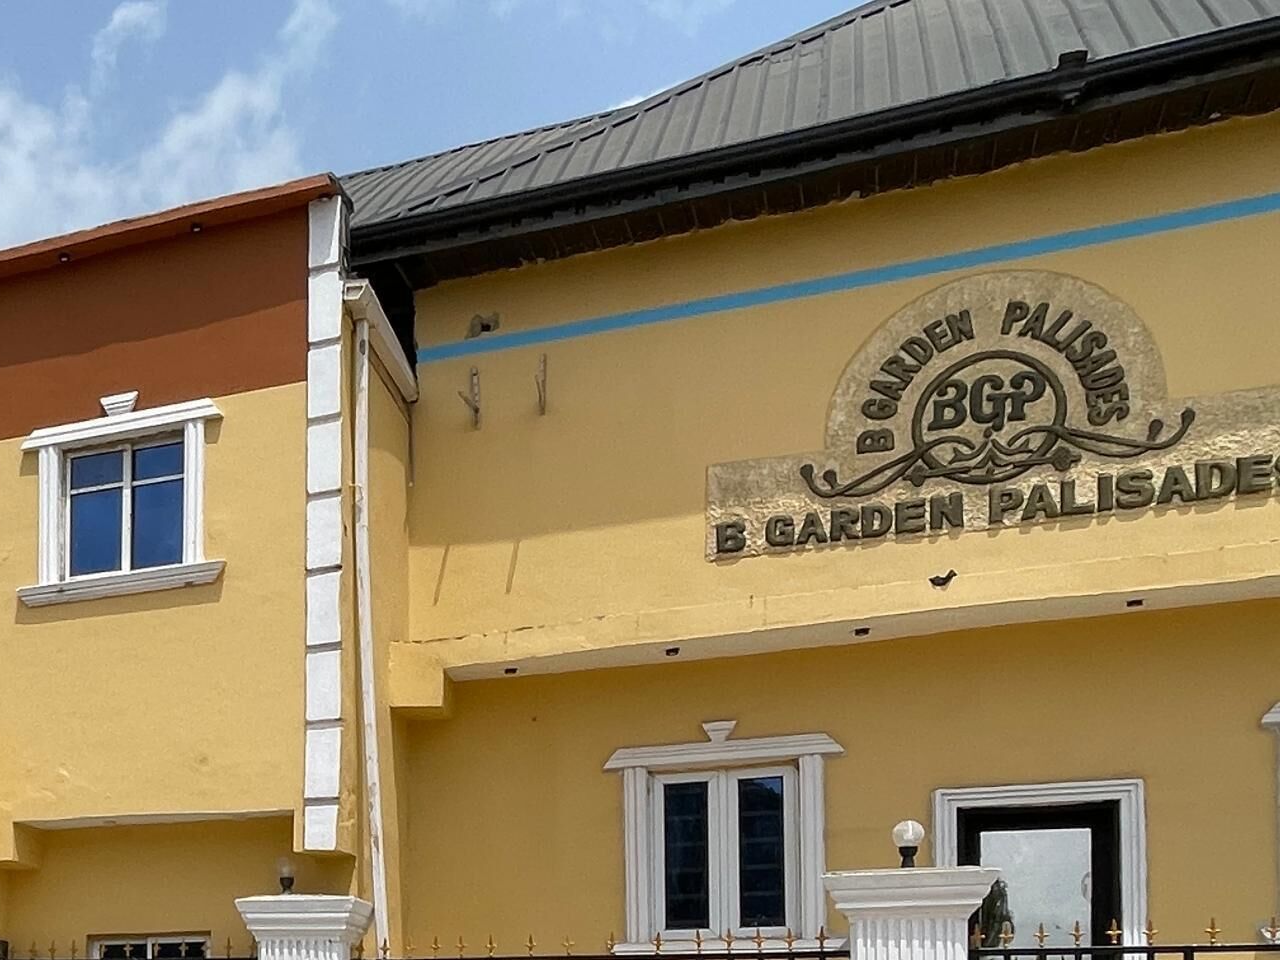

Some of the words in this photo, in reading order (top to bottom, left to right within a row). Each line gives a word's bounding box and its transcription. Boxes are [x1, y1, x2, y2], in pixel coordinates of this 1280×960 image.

[862, 309, 974, 421] GARDEN
[926, 370, 1046, 434] BGP
[1000, 300, 1131, 427] PALISADES
[857, 429, 894, 454] B
[715, 519, 747, 555] B
[764, 491, 964, 547] GARDEN
[987, 453, 1280, 525] PALISADE
